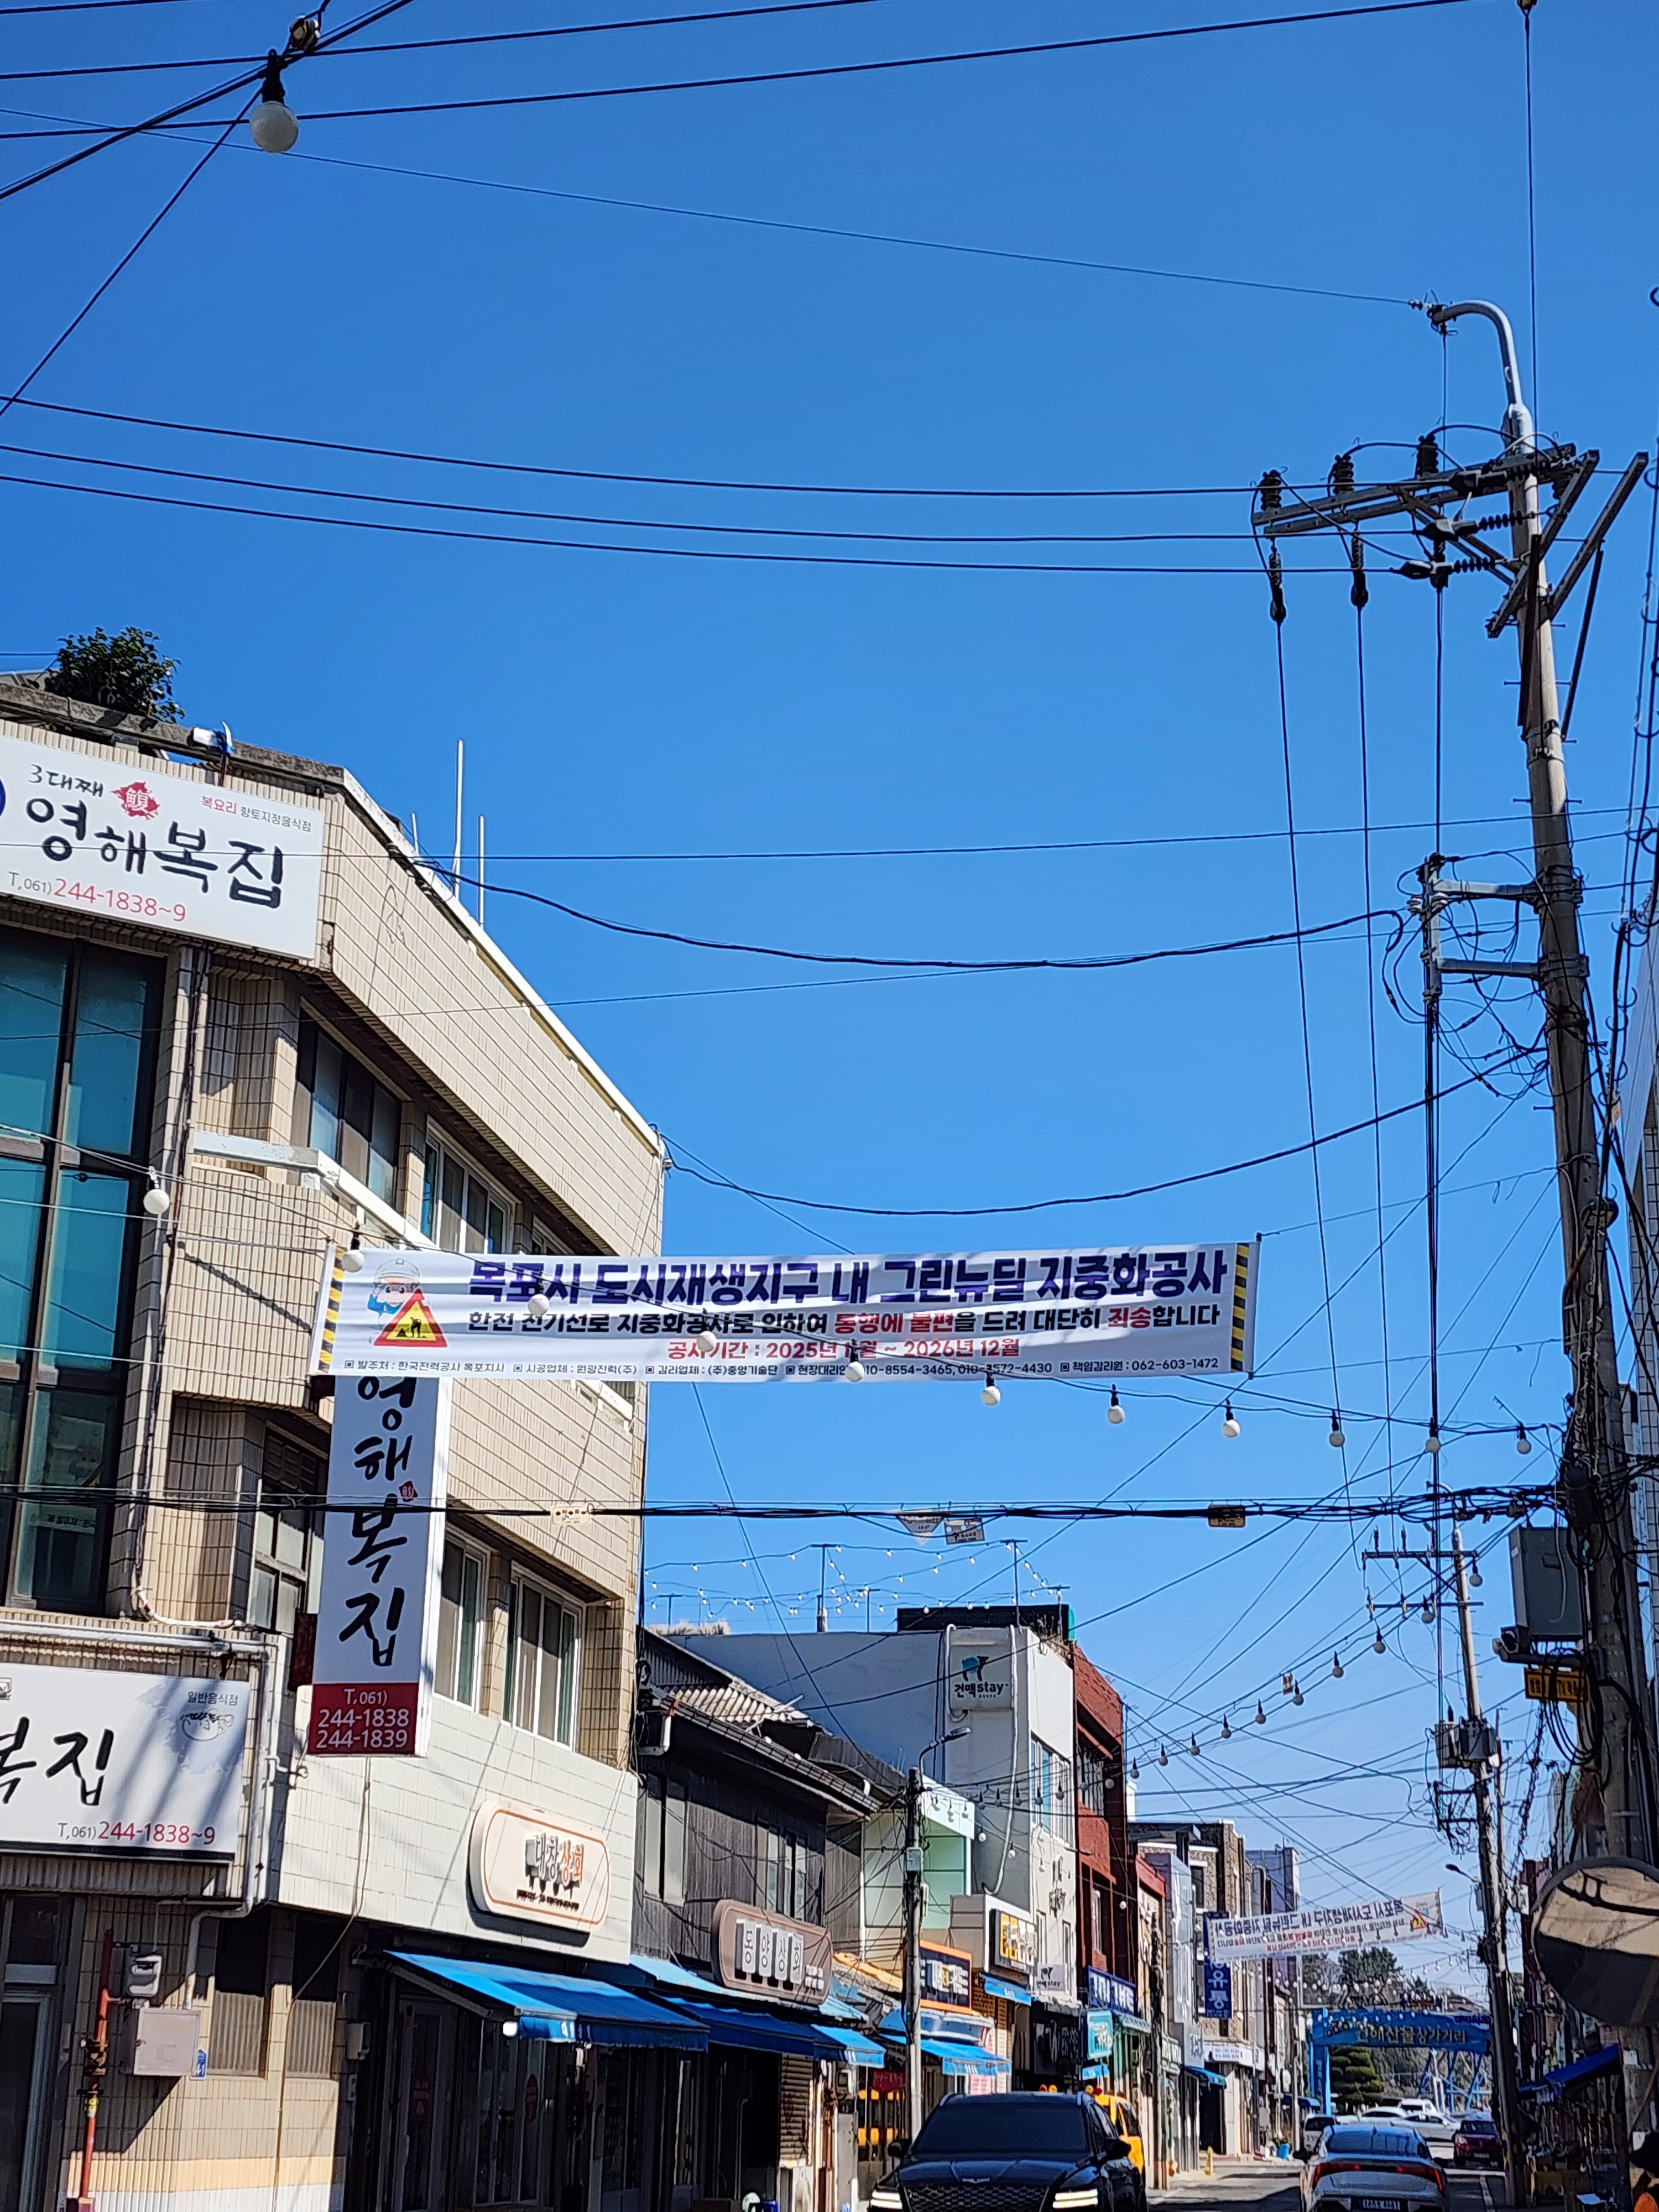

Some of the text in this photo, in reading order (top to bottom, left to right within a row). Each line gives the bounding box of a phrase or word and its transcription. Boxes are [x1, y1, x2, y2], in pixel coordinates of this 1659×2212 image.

[28, 764, 103, 797] 3대째
[201, 795, 311, 832] 복요리 향토지정음식점
[26, 799, 283, 909] 영해복집
[469, 1250, 1228, 1306] 목포시 도시재생지구 내 그린뉴딜 지중화공사
[469, 1304, 1220, 1334] 한전 전기선로 지중화공사로 인하여 통행에 불편을 드려 대단히 죄송합니다
[766, 1341, 837, 1359] 2025년
[904, 1339, 974, 1358] 2026년
[981, 1338, 1020, 1357] 12월
[358, 1360, 389, 1370] 발주처
[398, 1361, 461, 1372] 한국전력공사
[464, 1362, 504, 1373] 목포지사
[525, 1364, 567, 1374] 시공업체
[658, 1364, 699, 1375] 감리업체
[1073, 1360, 1123, 1372] 책임감리원
[1131, 1358, 1219, 1370] 062-603-1472
[187, 1691, 238, 1706] 일반음식점
[317, 1708, 409, 1728] 244-1838
[315, 1729, 408, 1749] 244-1839
